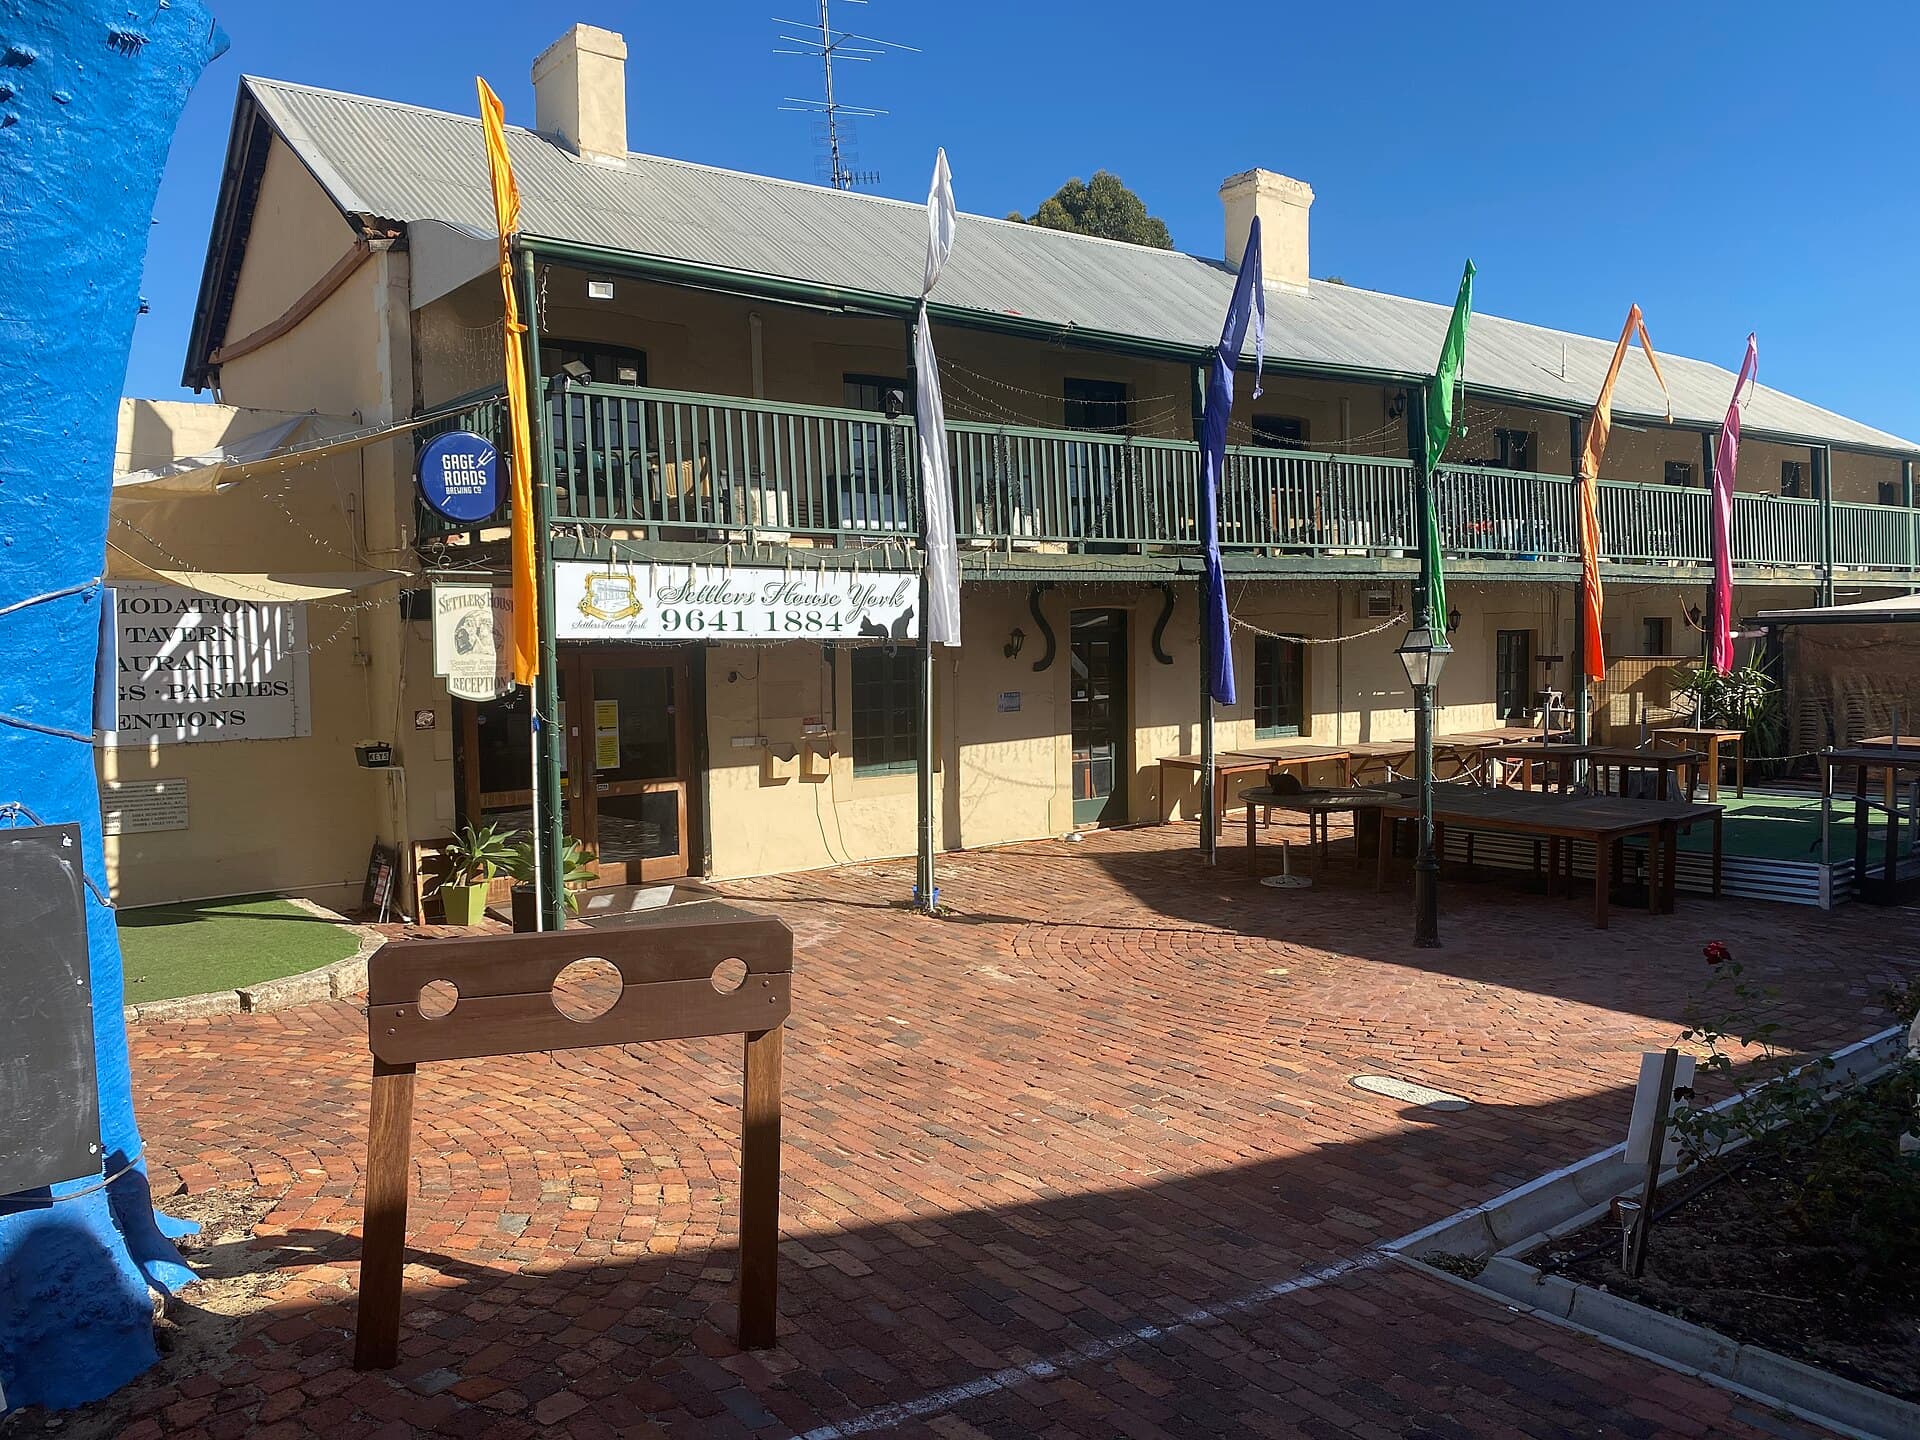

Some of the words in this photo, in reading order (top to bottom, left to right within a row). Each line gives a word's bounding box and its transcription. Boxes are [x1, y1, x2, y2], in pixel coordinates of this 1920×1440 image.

[442, 454, 475, 470] GAGE
[443, 470, 487, 486] ROADS
[445, 486, 472, 495] BREWING
[487, 592, 514, 613] HOUS
[656, 578, 756, 608] Settlers
[761, 582, 842, 607] House
[845, 577, 912, 624] York
[571, 620, 600, 630] Settlers
[601, 620, 626, 630] House
[626, 620, 649, 634] York
[661, 608, 749, 632] 9641
[763, 610, 843, 632] 1884
[126, 626, 239, 643] TAVERN
[167, 680, 289, 700] PARTIES
[453, 676, 507, 693] RECEPTION
[118, 709, 246, 730] ENTIONS
[369, 752, 389, 760] KEYS
